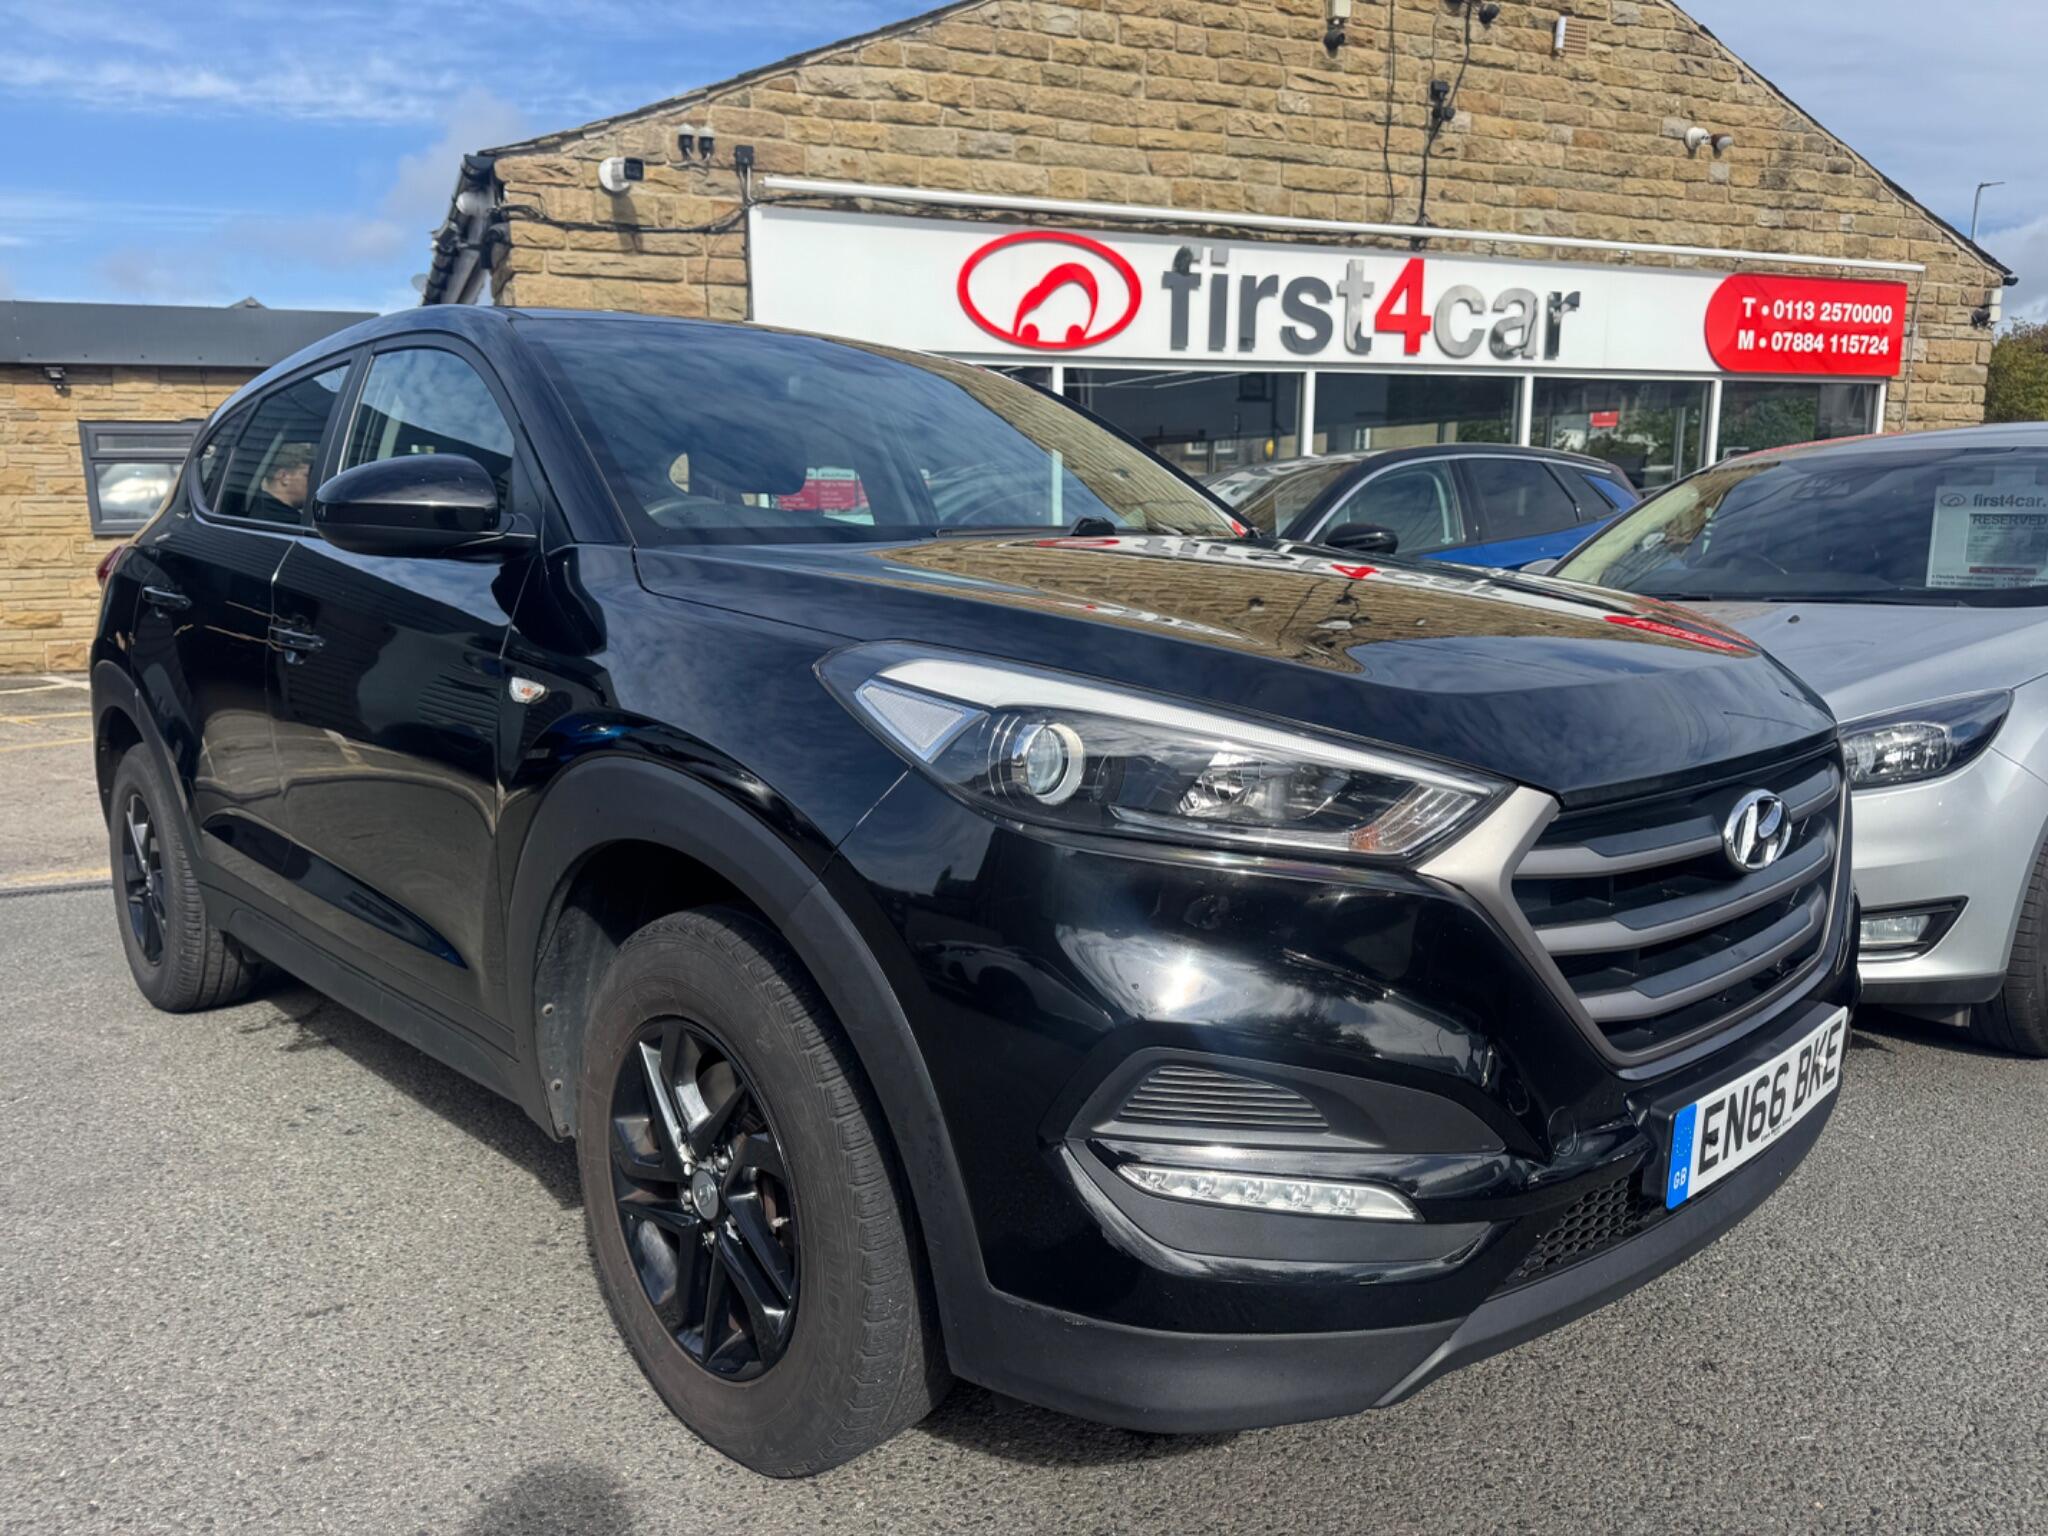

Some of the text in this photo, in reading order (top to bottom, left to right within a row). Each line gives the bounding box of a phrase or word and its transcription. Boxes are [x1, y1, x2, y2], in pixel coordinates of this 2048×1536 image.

[1161, 245, 1581, 361] first4car
[1742, 297, 1893, 324] T 0113 2570000
[1738, 329, 1890, 354] M 07884 115724
[1971, 513, 2047, 526] RESERVED
[1697, 1018, 1843, 1176] EN66 BKE
[1673, 1166, 1688, 1190] GB
